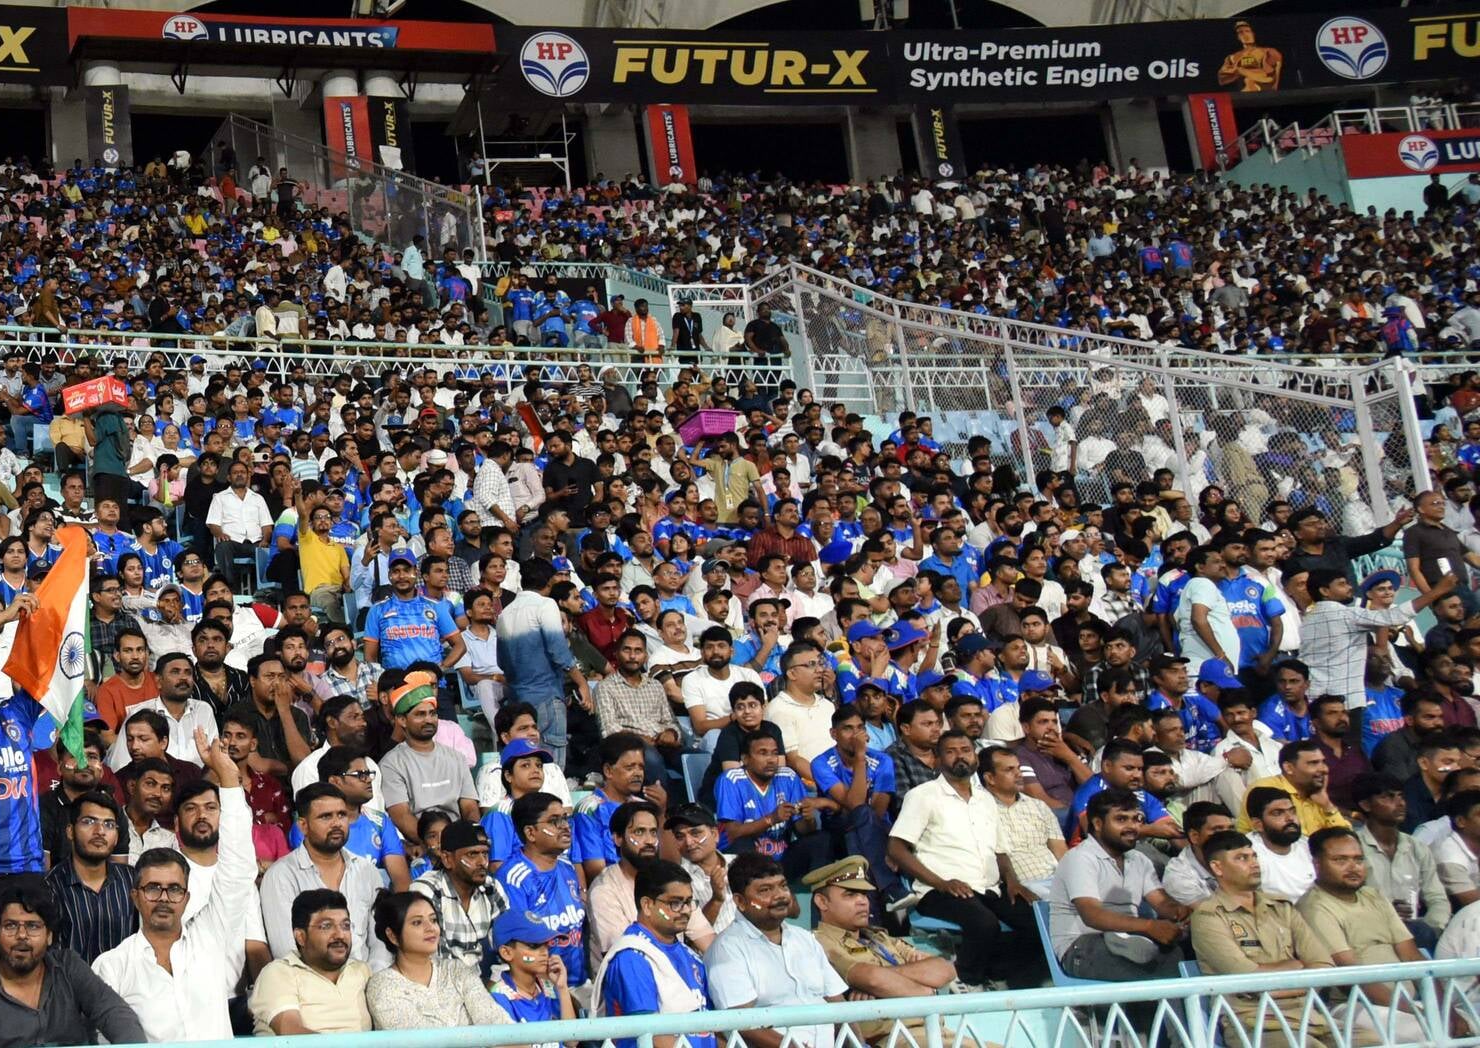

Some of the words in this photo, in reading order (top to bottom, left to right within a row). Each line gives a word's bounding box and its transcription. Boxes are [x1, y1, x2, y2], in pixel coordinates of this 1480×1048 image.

[174, 21, 198, 33] HP
[1330, 26, 1368, 45] HP
[536, 42, 573, 60] HP
[613, 47, 869, 86] FUTUR-X
[903, 40, 1101, 61] Ultra-Premium
[909, 67, 1038, 91] Synthetic
[1046, 63, 1140, 88] Engine
[1148, 58, 1200, 80] Oils
[104, 91, 114, 144] FUTUR-X
[343, 106, 355, 156] LUBRICANTS
[385, 101, 396, 147] UTUR-X
[931, 107, 947, 160] FUTUR-X
[1207, 103, 1223, 150] LUBRICANTS
[664, 114, 678, 163] LUBRICANTS
[1407, 141, 1427, 152] HP
[1445, 141, 1480, 160] LU
